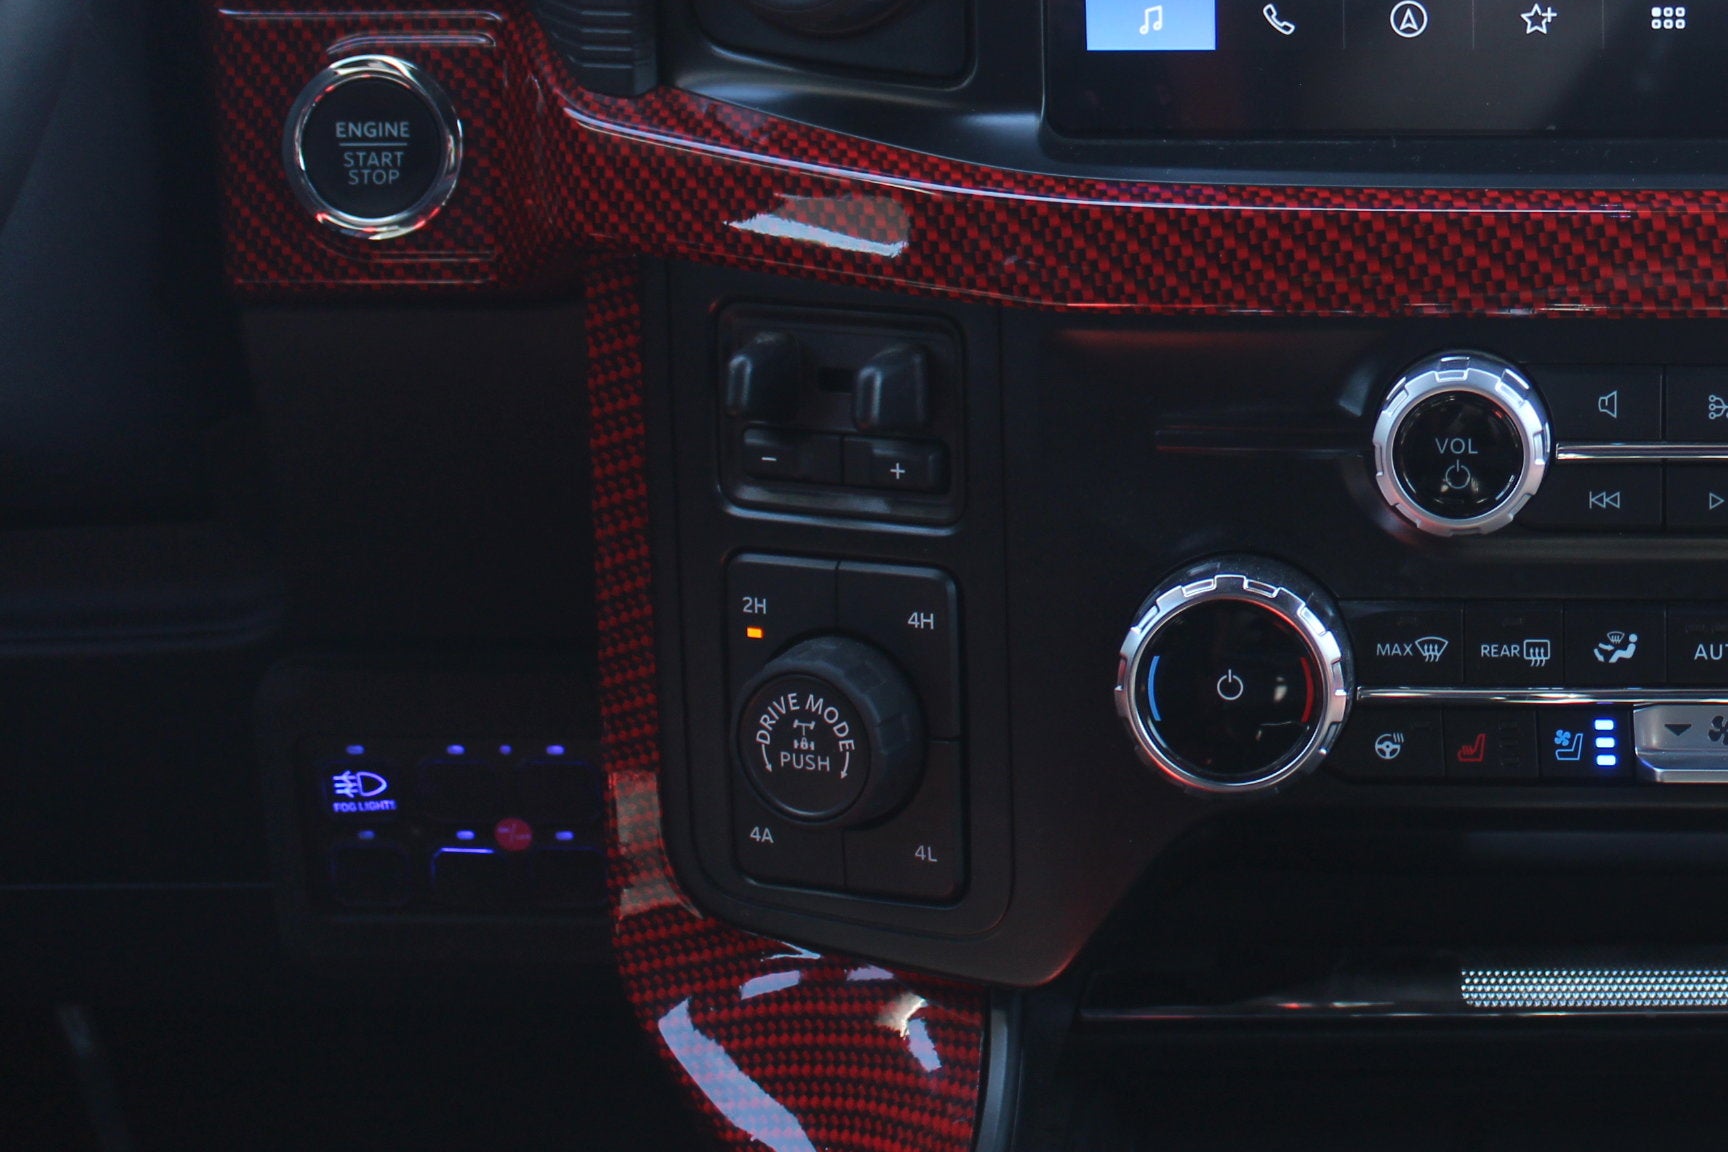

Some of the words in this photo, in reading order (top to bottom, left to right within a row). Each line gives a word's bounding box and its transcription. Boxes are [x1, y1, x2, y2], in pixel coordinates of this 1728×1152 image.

[335, 121, 410, 138] ENGINE
[343, 151, 404, 168] START
[348, 169, 400, 185] STOP
[1435, 437, 1478, 455] VOL
[742, 596, 767, 615] 2H
[908, 612, 935, 630] 4H
[1376, 642, 1412, 656] MAX
[1480, 644, 1520, 659] REAR
[755, 692, 801, 746] DRIVE
[805, 694, 856, 753] MODE
[779, 752, 831, 772] PUSH
[333, 802, 357, 812] FOG
[749, 825, 774, 845] 4A
[914, 844, 938, 864] 4L
